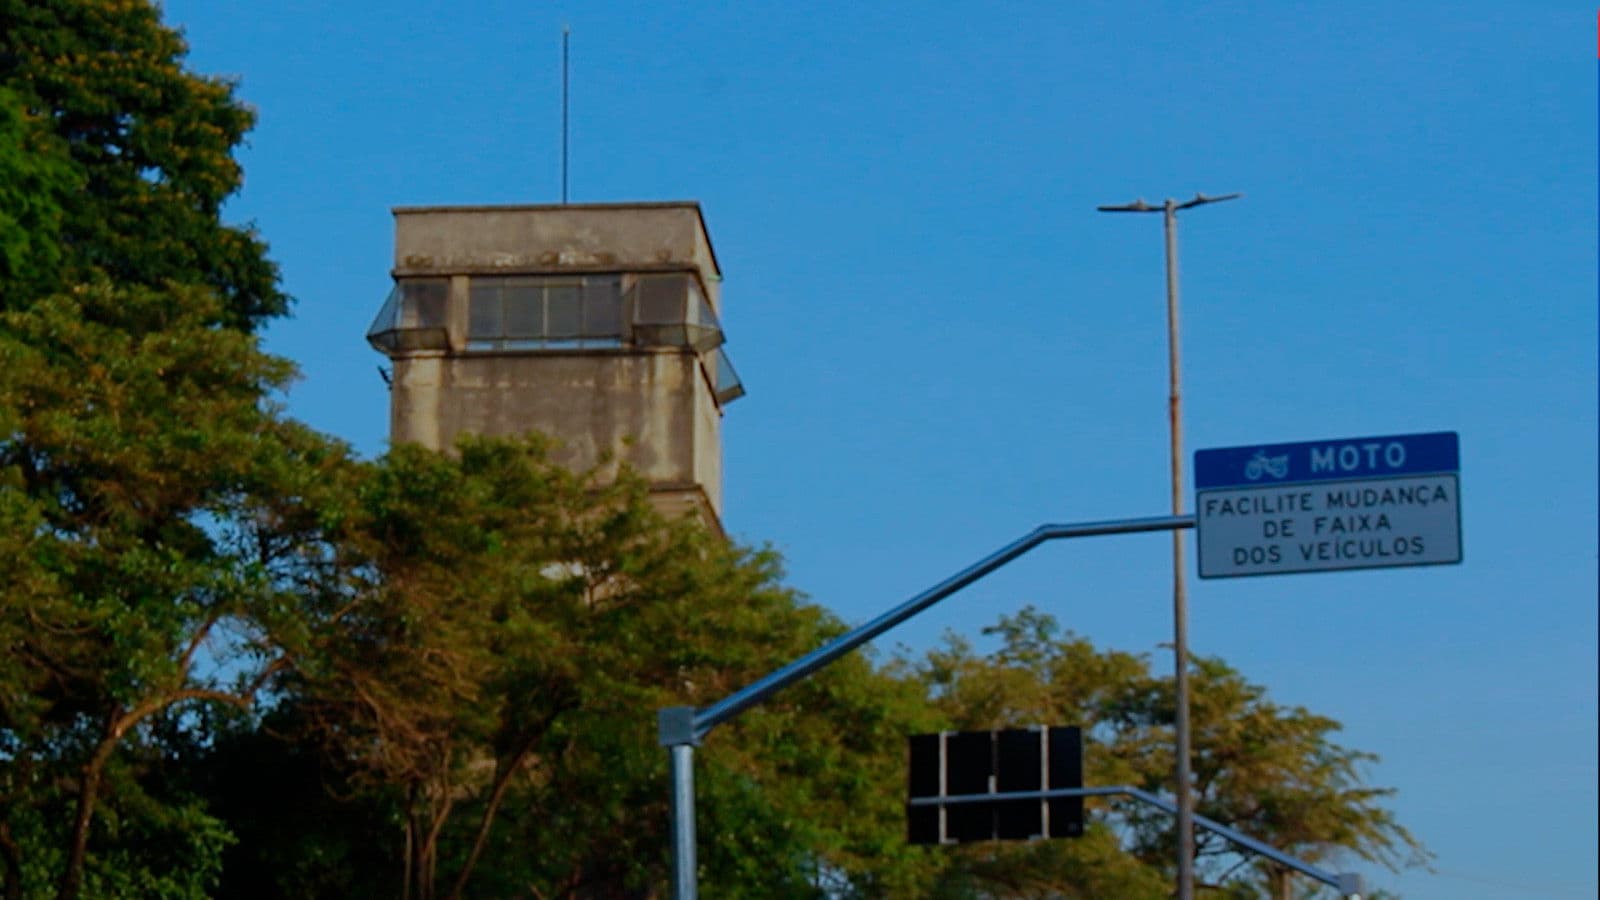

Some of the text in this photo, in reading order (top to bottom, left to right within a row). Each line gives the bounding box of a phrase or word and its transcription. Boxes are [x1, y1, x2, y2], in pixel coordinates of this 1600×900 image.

[1310, 441, 1406, 473] MOTO
[1204, 484, 1449, 517] FACILITE MUDANÇA
[1263, 513, 1392, 539] DE FAIXA
[1233, 536, 1425, 566] DOS VEÍCULOS
